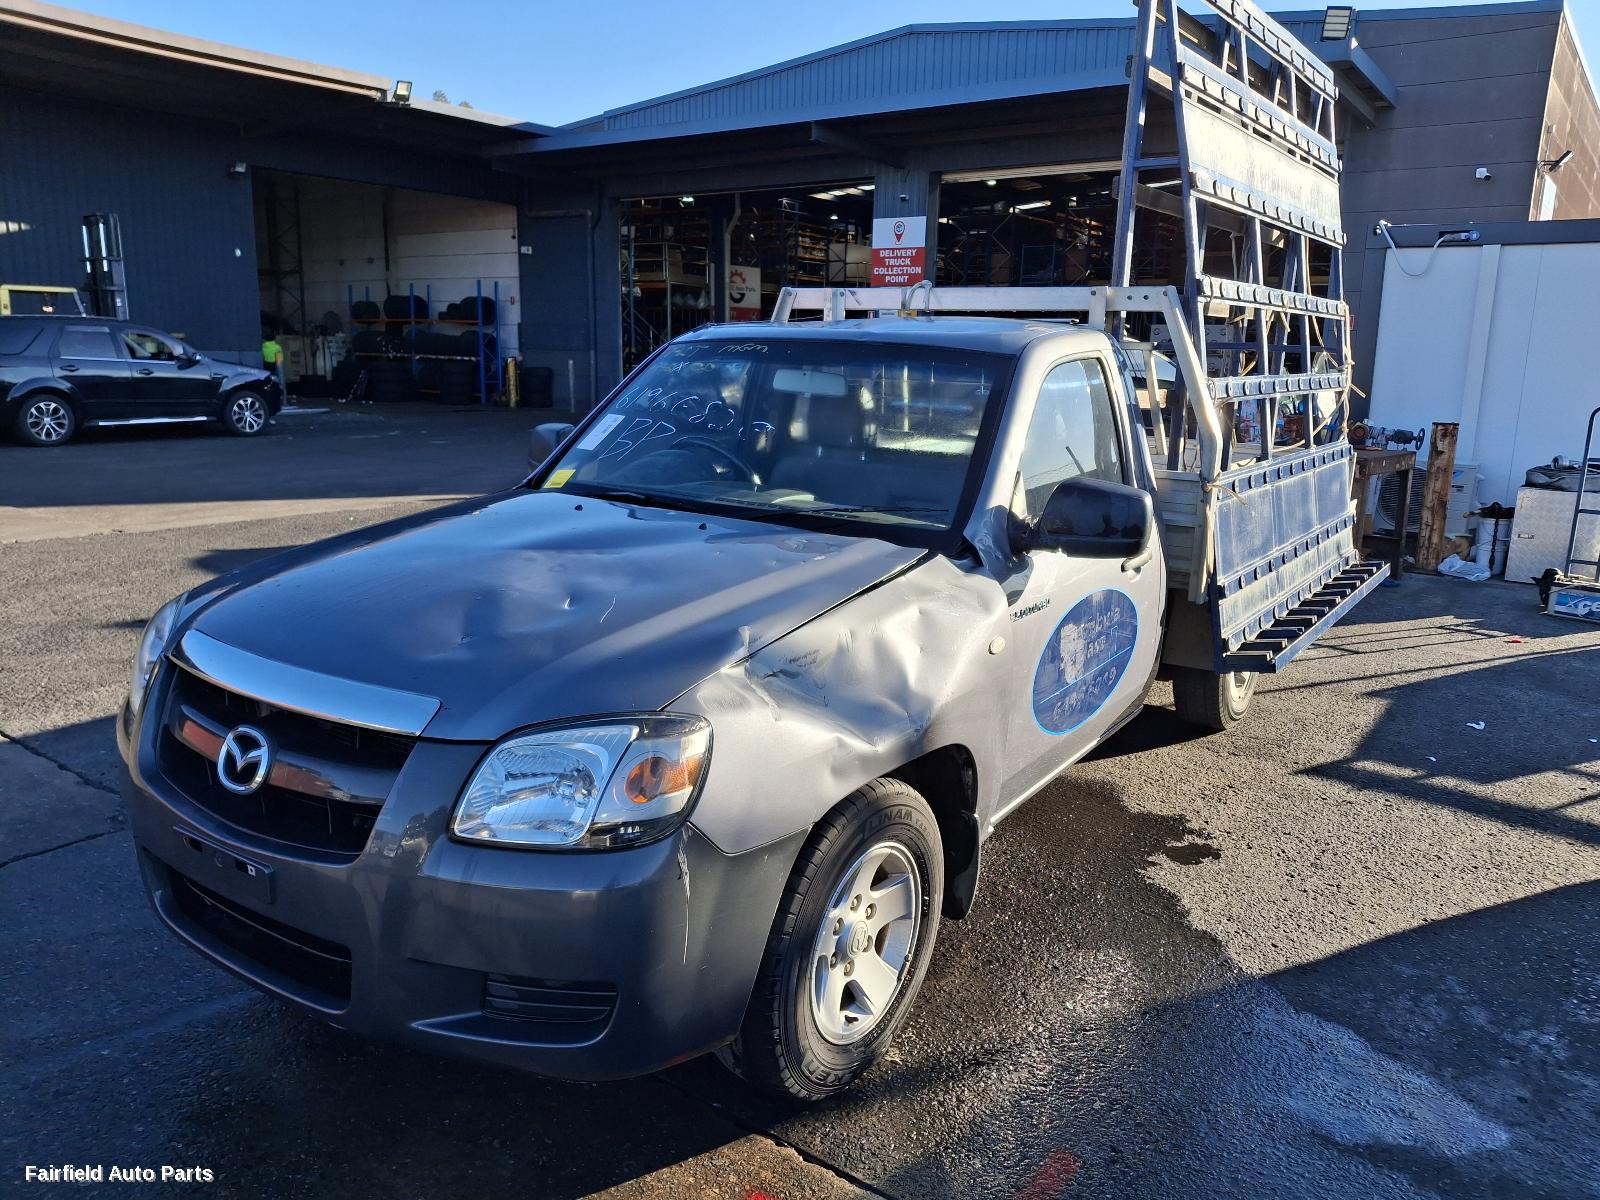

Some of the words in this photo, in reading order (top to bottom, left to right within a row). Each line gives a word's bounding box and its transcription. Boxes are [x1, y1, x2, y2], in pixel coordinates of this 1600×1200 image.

[879, 249, 917, 257] DELIVERY
[884, 258, 911, 266] TRUCK
[873, 266, 922, 275] COLLECTION
[885, 275, 909, 283] POINT
